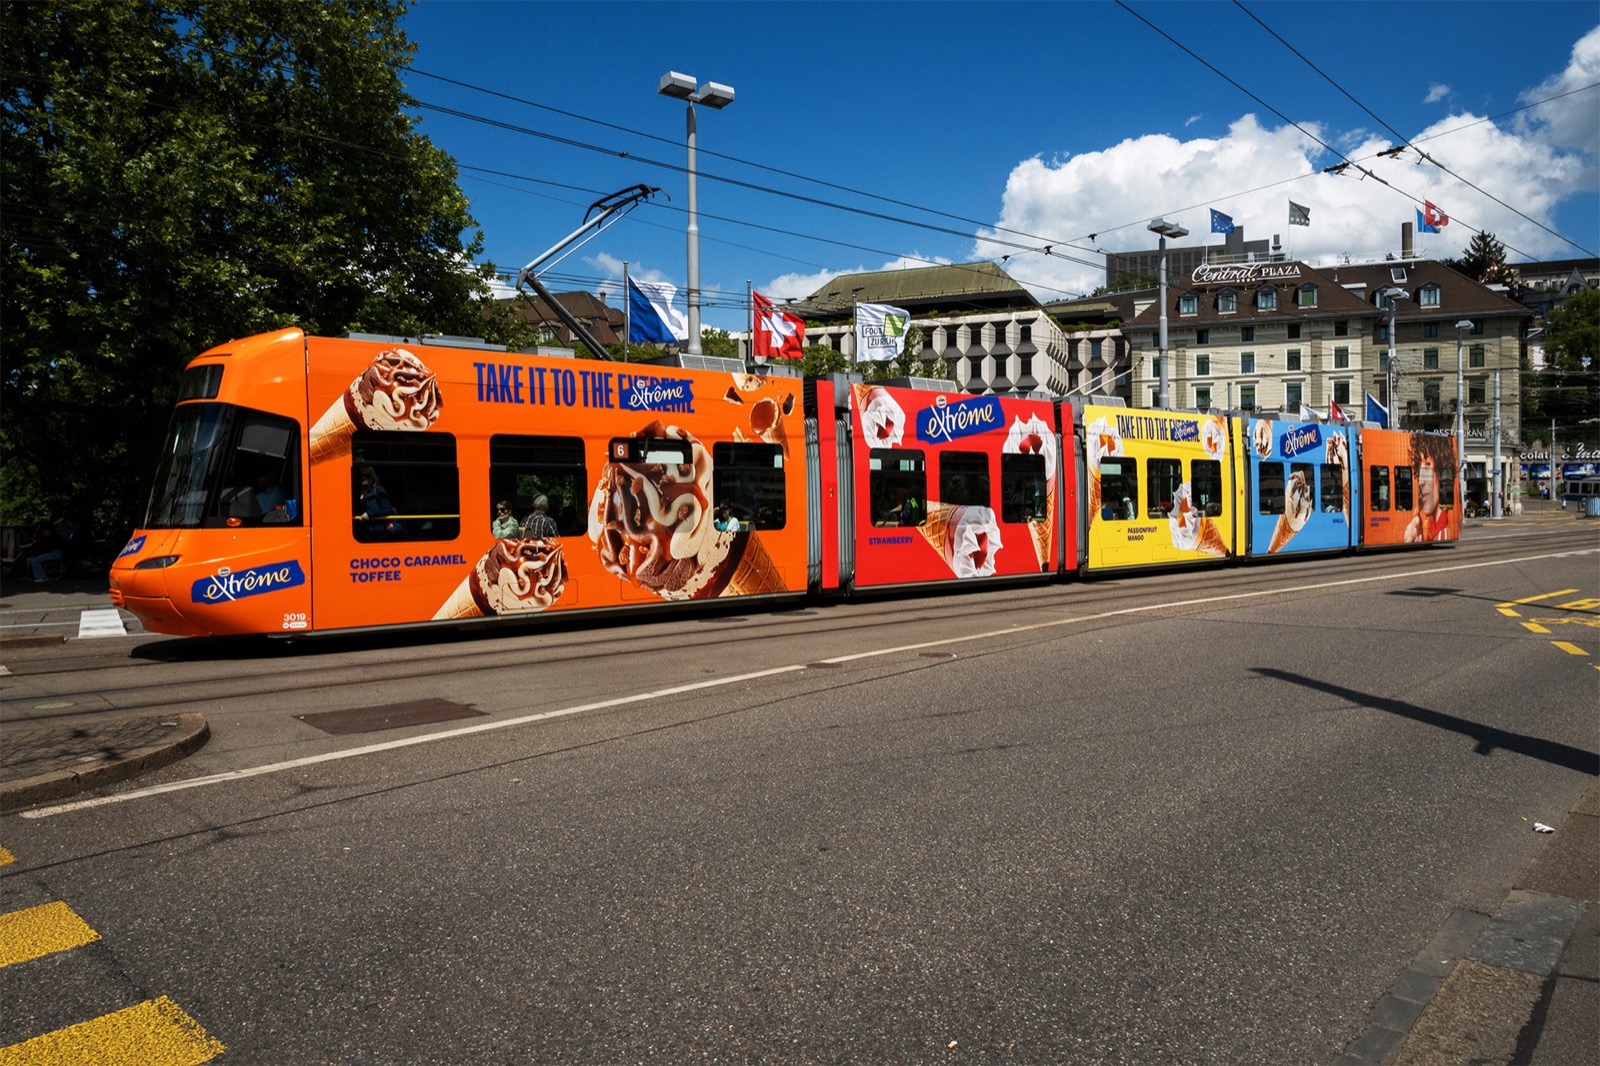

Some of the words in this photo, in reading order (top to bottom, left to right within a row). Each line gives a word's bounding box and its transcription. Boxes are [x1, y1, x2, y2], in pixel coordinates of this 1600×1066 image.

[1191, 262, 1261, 283] Central
[1261, 265, 1301, 277] PLAZA
[473, 362, 525, 404] TAKE
[528, 366, 547, 405] IT
[550, 368, 576, 407] TO
[579, 370, 615, 409] THE
[1116, 414, 1136, 439] TAKE
[1136, 416, 1143, 440] IT
[1144, 416, 1155, 440] TO
[1155, 417, 1169, 441] THE
[617, 444, 625, 457] 6
[1127, 526, 1157, 534] PASSIONFRUIT
[868, 535, 913, 545] STRAWBERRY
[350, 556, 401, 570] CHOCO
[404, 554, 467, 567] CARAMEL
[350, 570, 401, 583] TOFFEE
[283, 612, 306, 622] 3019
